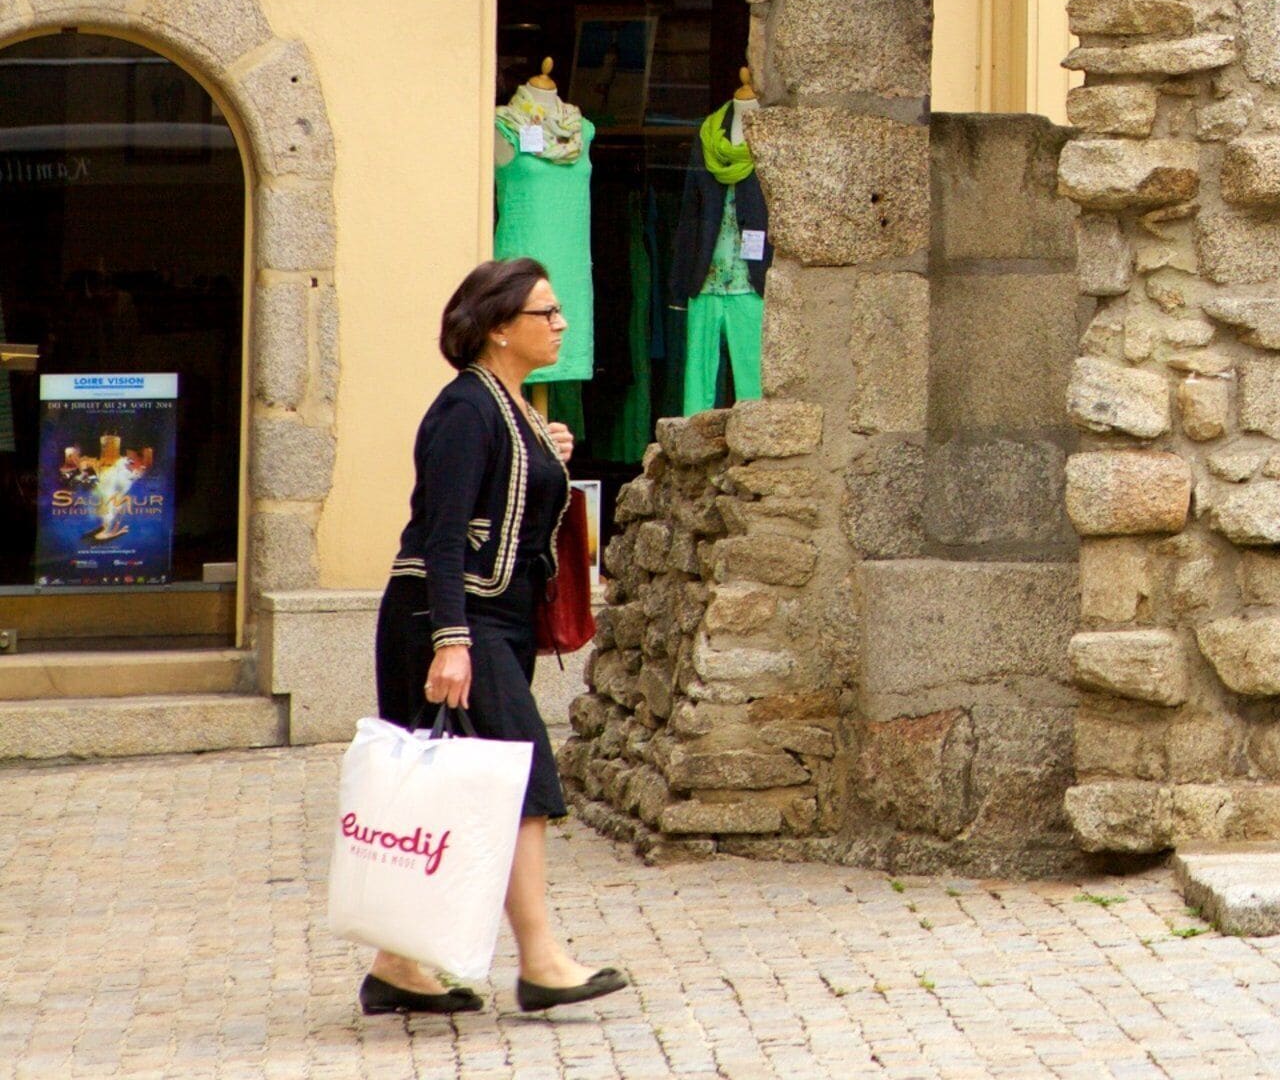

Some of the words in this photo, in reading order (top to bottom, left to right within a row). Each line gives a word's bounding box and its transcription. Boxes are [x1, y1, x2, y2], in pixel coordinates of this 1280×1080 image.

[74, 377, 103, 385] LOIRE
[107, 377, 144, 385] VISION
[341, 812, 451, 876] eurodif
